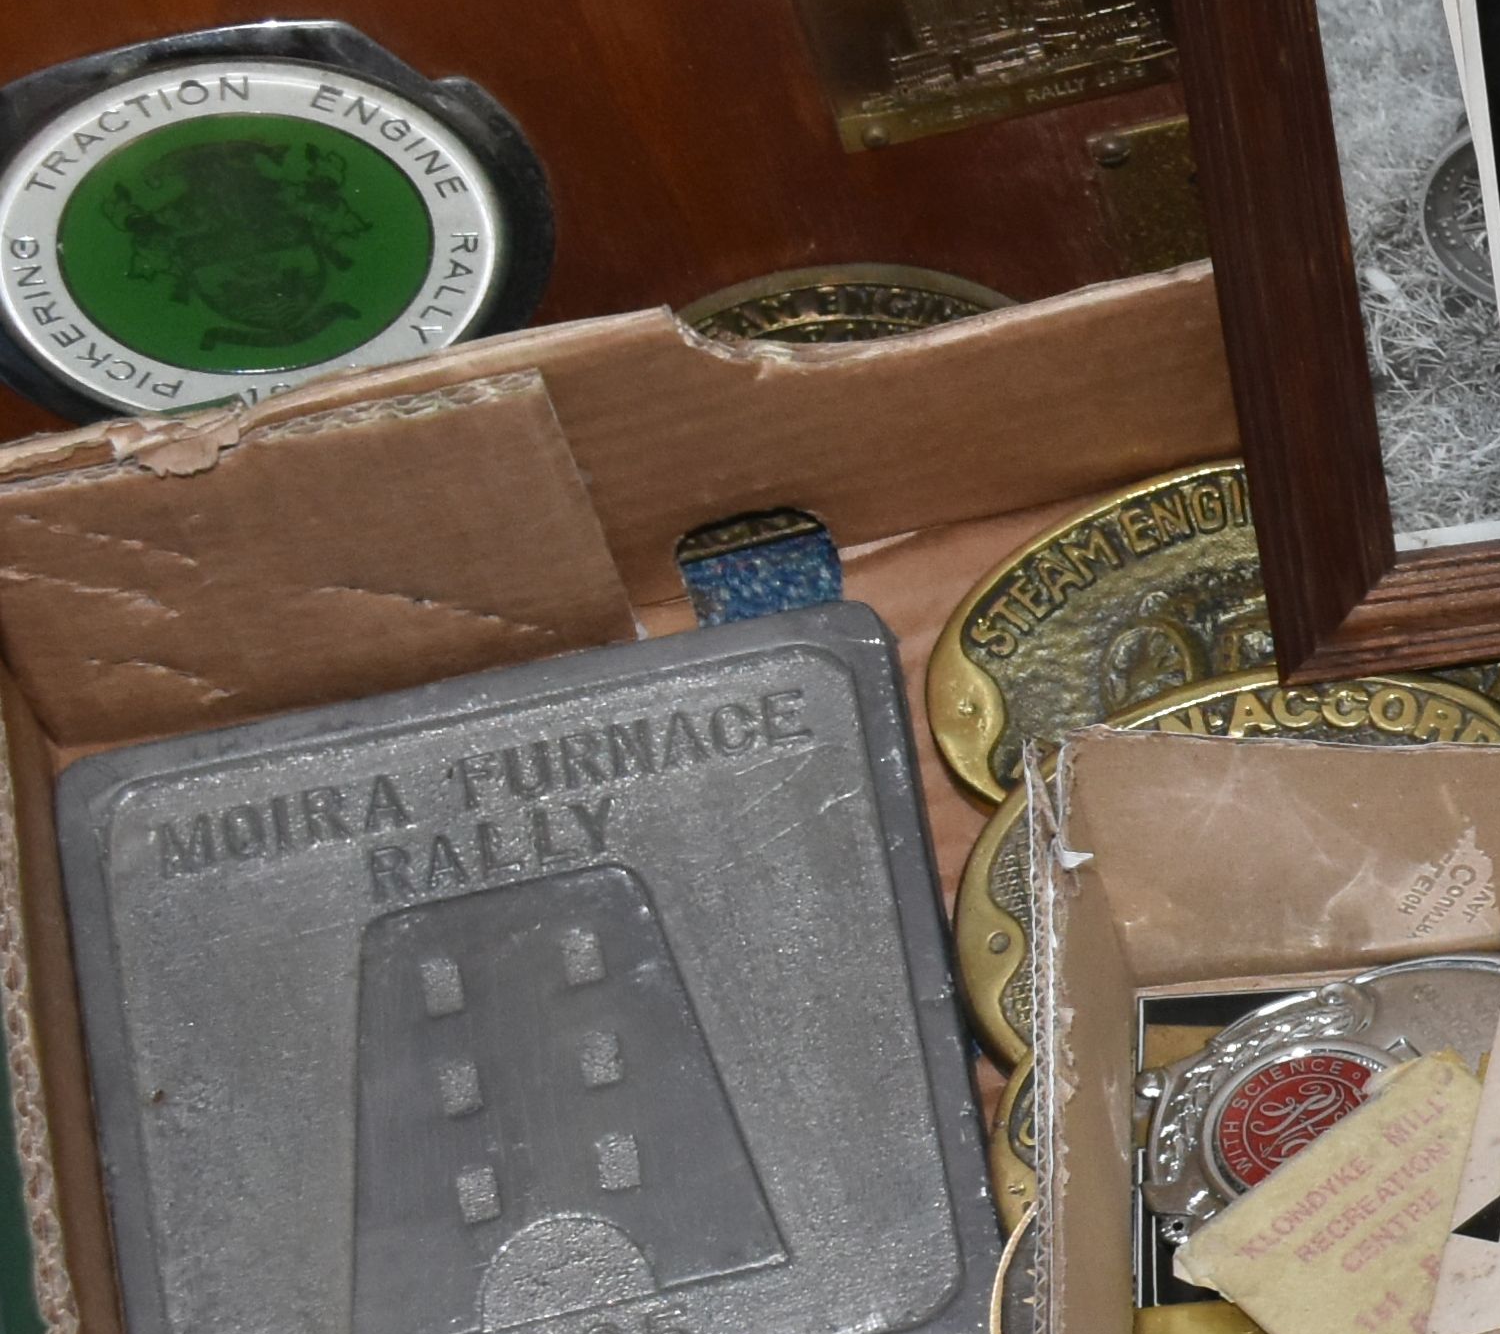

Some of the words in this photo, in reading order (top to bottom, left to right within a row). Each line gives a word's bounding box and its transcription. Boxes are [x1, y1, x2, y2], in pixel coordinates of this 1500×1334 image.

[25, 75, 250, 194] TRACTION
[310, 82, 469, 200] ENGINE
[410, 230, 479, 344] RALLY
[9, 234, 183, 399] PICKERING
[970, 524, 1124, 658] STEAM
[156, 775, 412, 879] MOIRA
[457, 689, 815, 811] FURNACE
[367, 797, 619, 902] RALLY
[1232, 1059, 1343, 1111] SCIENCE
[1223, 1119, 1252, 1176] WITH
[1295, 1142, 1450, 1264] RECREATION
[1240, 1155, 1371, 1261] KLONDYKE
[1340, 1189, 1441, 1274] CENTRE
